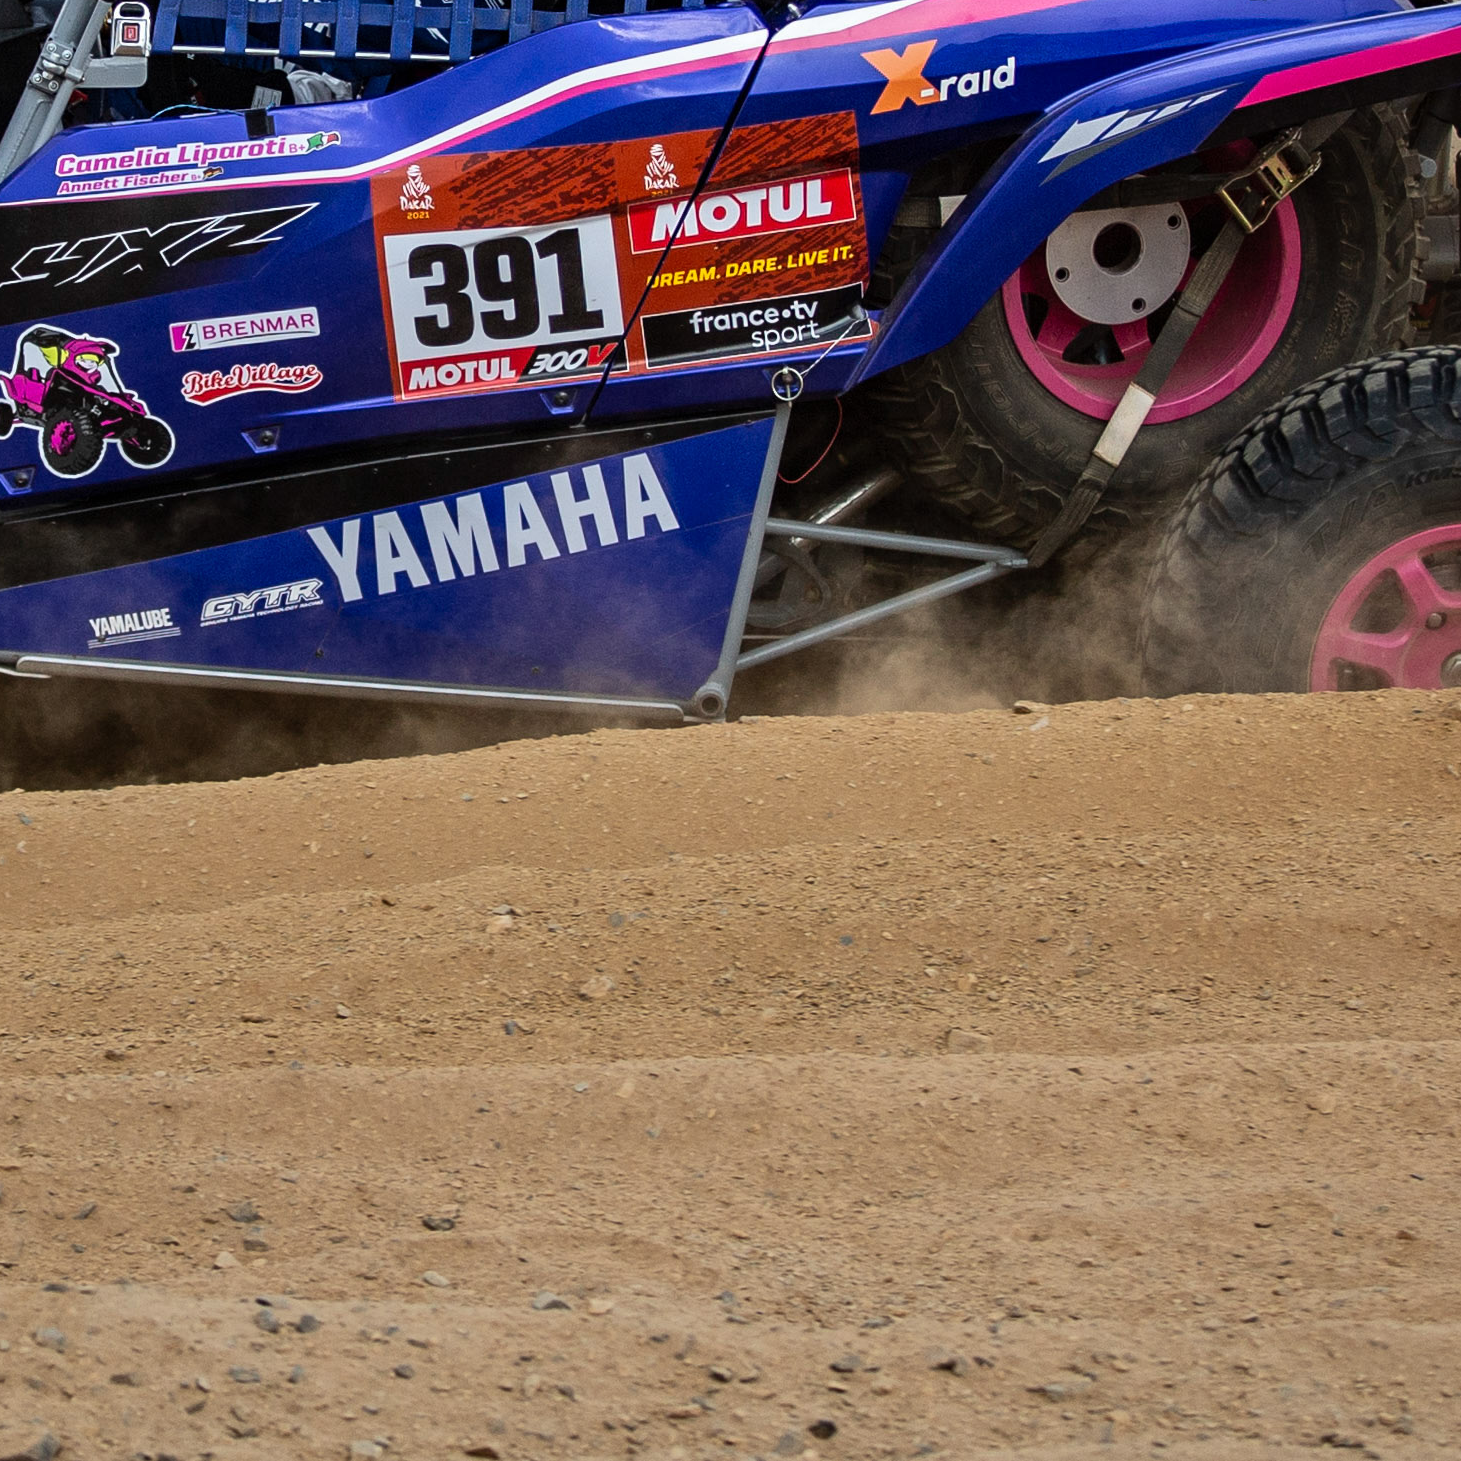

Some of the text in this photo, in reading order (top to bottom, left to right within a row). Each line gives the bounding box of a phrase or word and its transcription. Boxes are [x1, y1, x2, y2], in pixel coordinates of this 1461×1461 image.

[57, 149, 170, 175] Camelia
[177, 137, 287, 165] Liparoti
[58, 178, 119, 194] Annett
[122, 172, 189, 188] Fischer
[643, 173, 680, 191] DAKAR
[399, 196, 436, 211] DAKAR
[406, 211, 430, 220] 2021
[650, 178, 833, 243] MOTUL
[725, 257, 783, 279] DARE.
[786, 248, 829, 269] LIVE
[832, 245, 855, 262] IT.
[408, 227, 605, 348] 391
[202, 313, 316, 340] BRENMAR
[751, 320, 820, 351] sport
[408, 342, 619, 391] MOTUL 300V
[306, 452, 680, 603] YAMAHA
[201, 578, 323, 621] GYTR
[89, 607, 174, 637] YAMALUBE
